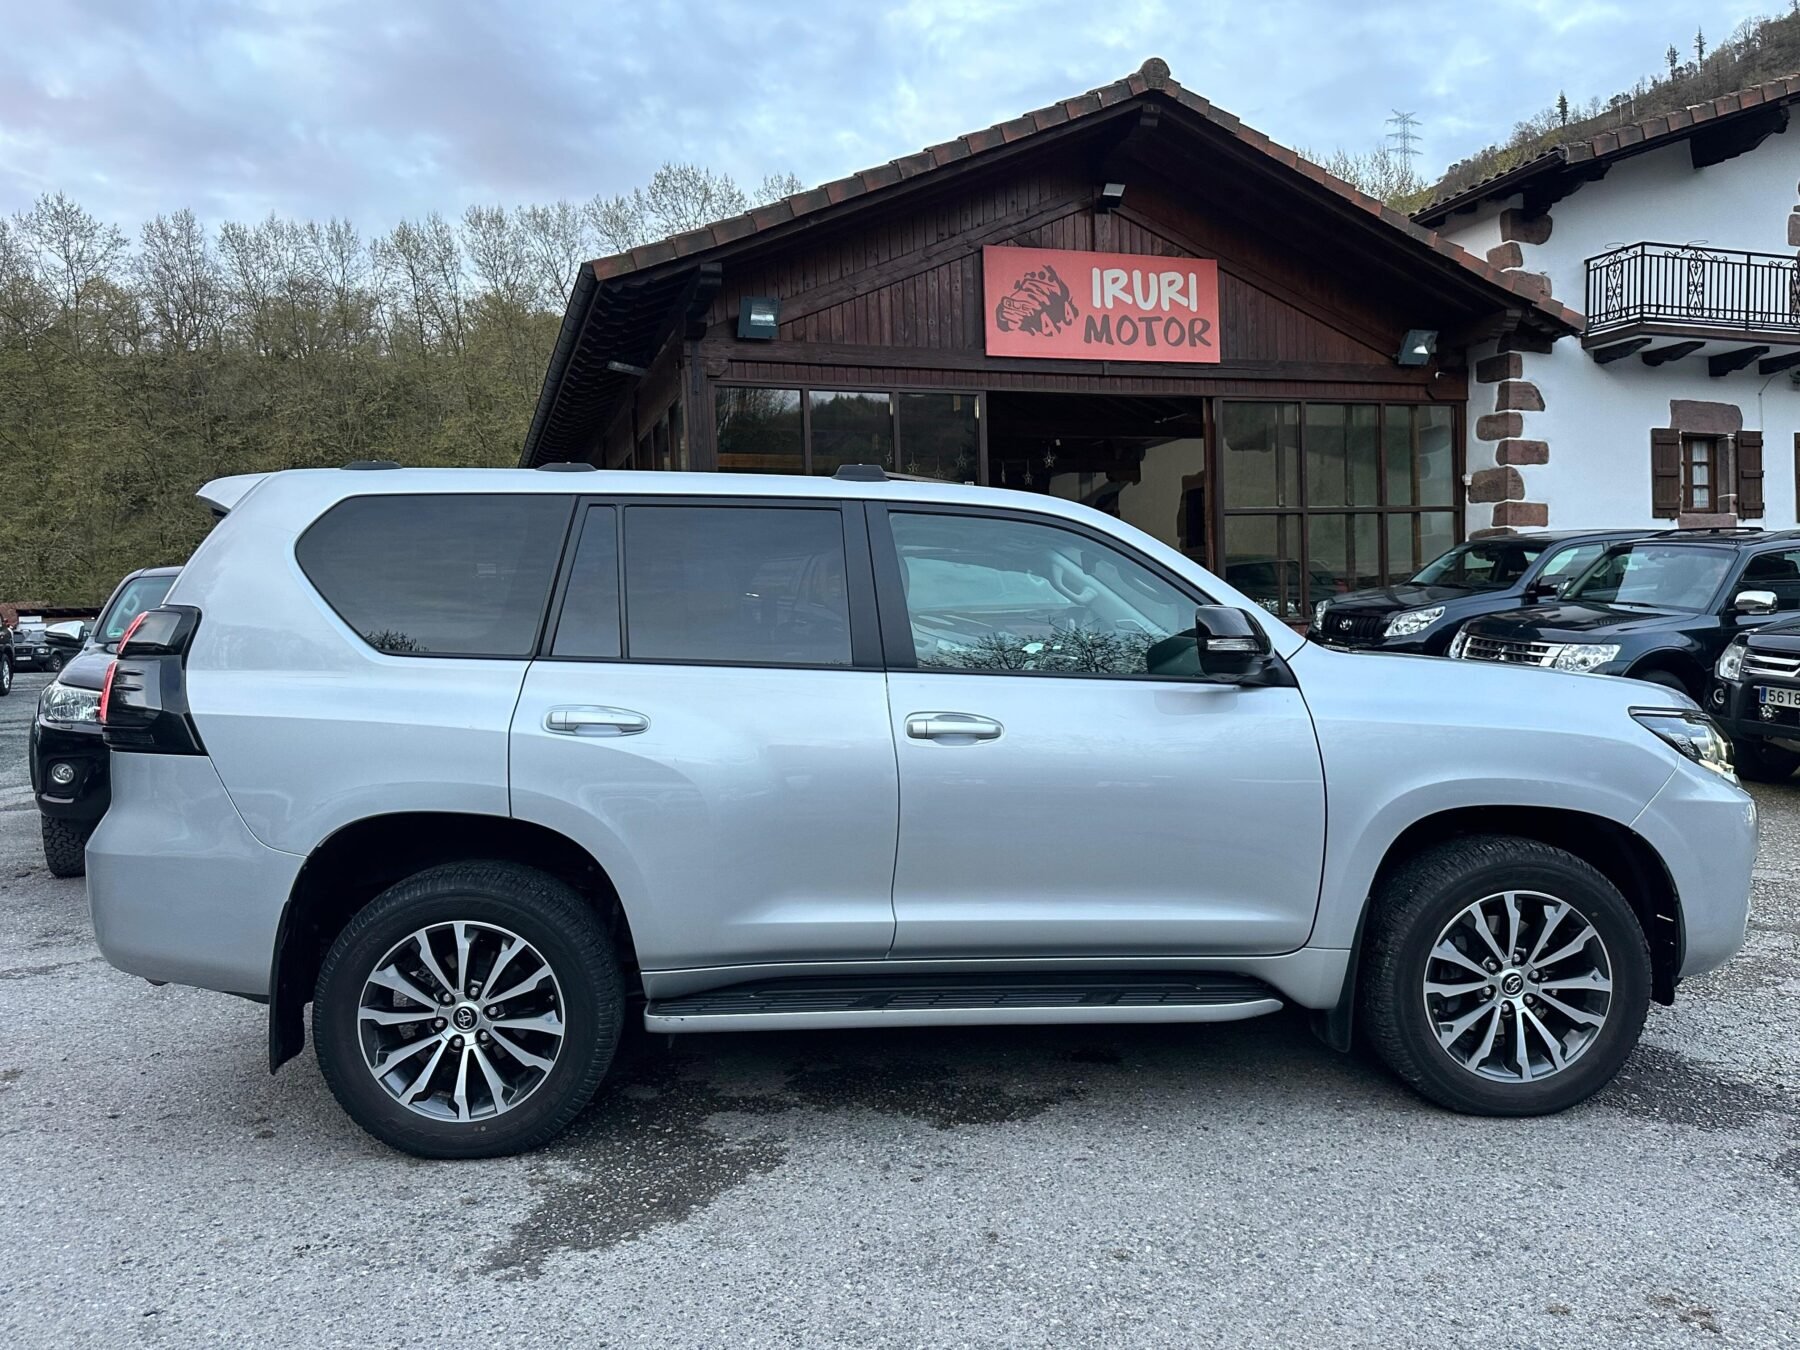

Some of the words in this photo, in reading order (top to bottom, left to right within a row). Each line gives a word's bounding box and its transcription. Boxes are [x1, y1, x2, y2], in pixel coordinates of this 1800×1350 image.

[1091, 267, 1198, 312] IRURI
[1083, 313, 1212, 348] MOTOR
[1768, 689, 1800, 706] 5618
